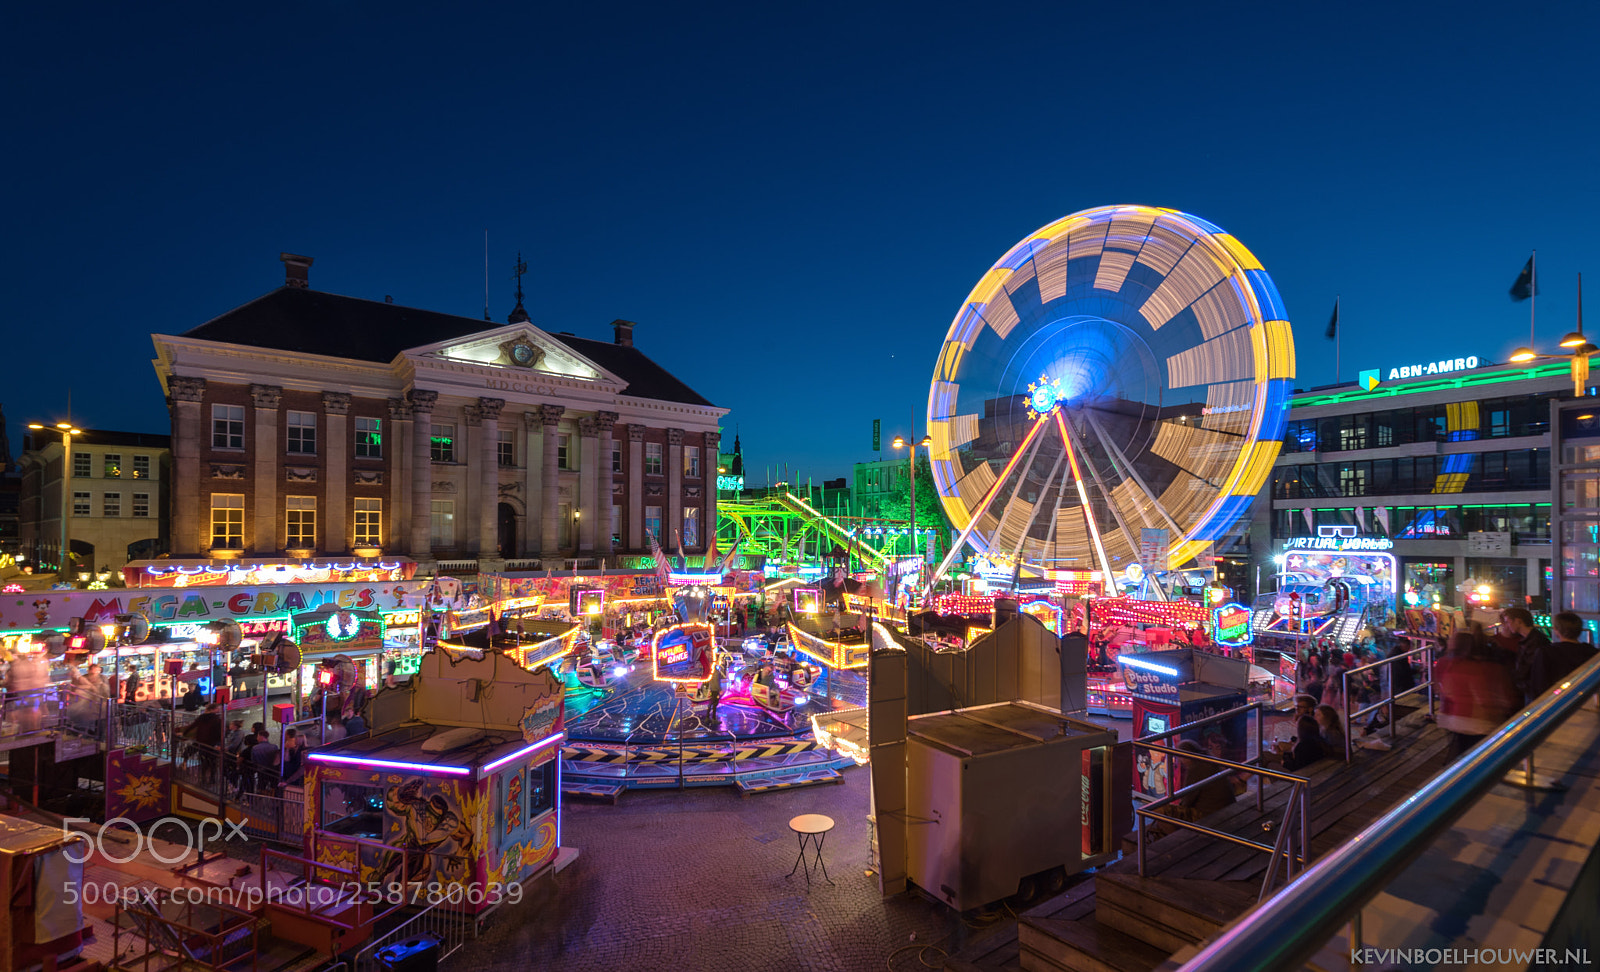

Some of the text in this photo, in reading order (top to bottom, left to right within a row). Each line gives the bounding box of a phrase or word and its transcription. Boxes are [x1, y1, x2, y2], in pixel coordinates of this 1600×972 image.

[486, 379, 557, 396] MDCCCX
[716, 475, 744, 490] ouse
[1283, 537, 1338, 550] VIRTUAL
[84, 588, 376, 621] MEGA-CRANES
[1129, 672, 1160, 684] Photo
[1144, 684, 1178, 695] Studio
